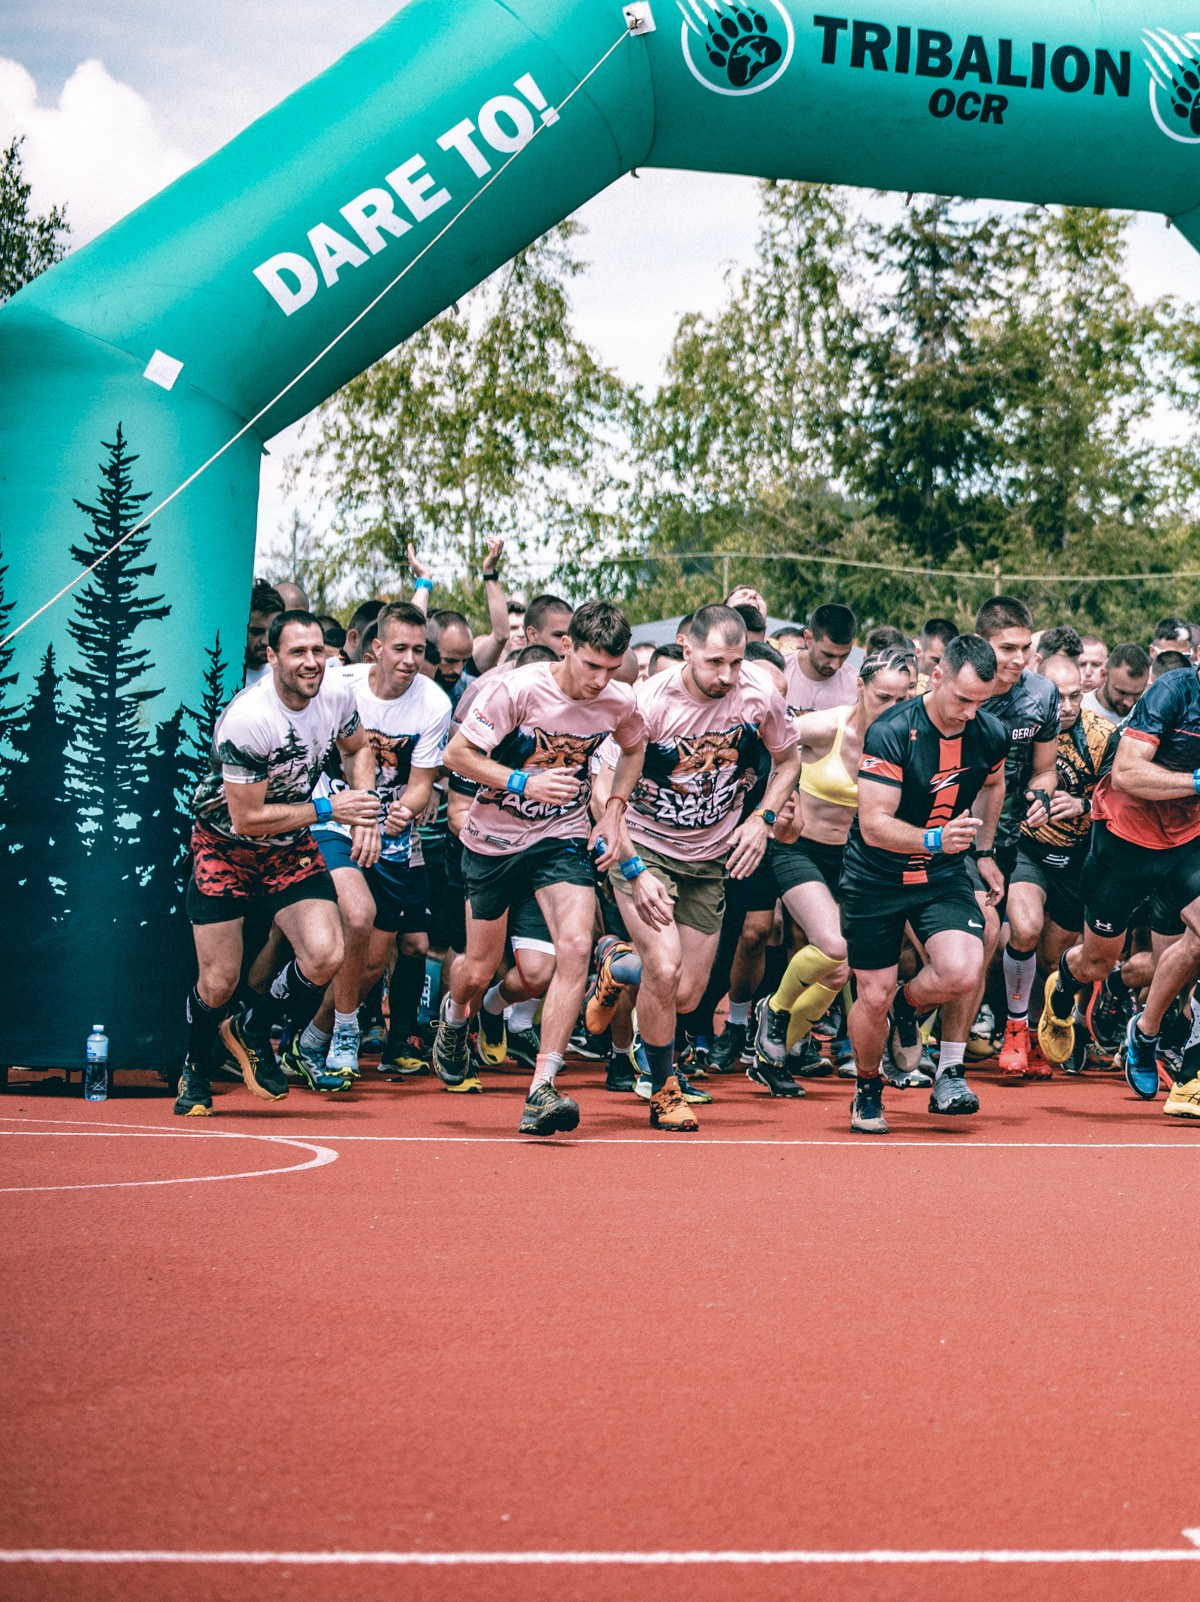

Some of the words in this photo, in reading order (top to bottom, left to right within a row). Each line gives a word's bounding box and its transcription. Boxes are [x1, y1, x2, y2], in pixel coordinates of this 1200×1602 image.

[813, 15, 1132, 98] TRIBALION
[927, 88, 1009, 125] OCR
[252, 153, 453, 317] DARE
[436, 72, 561, 179] TO!
